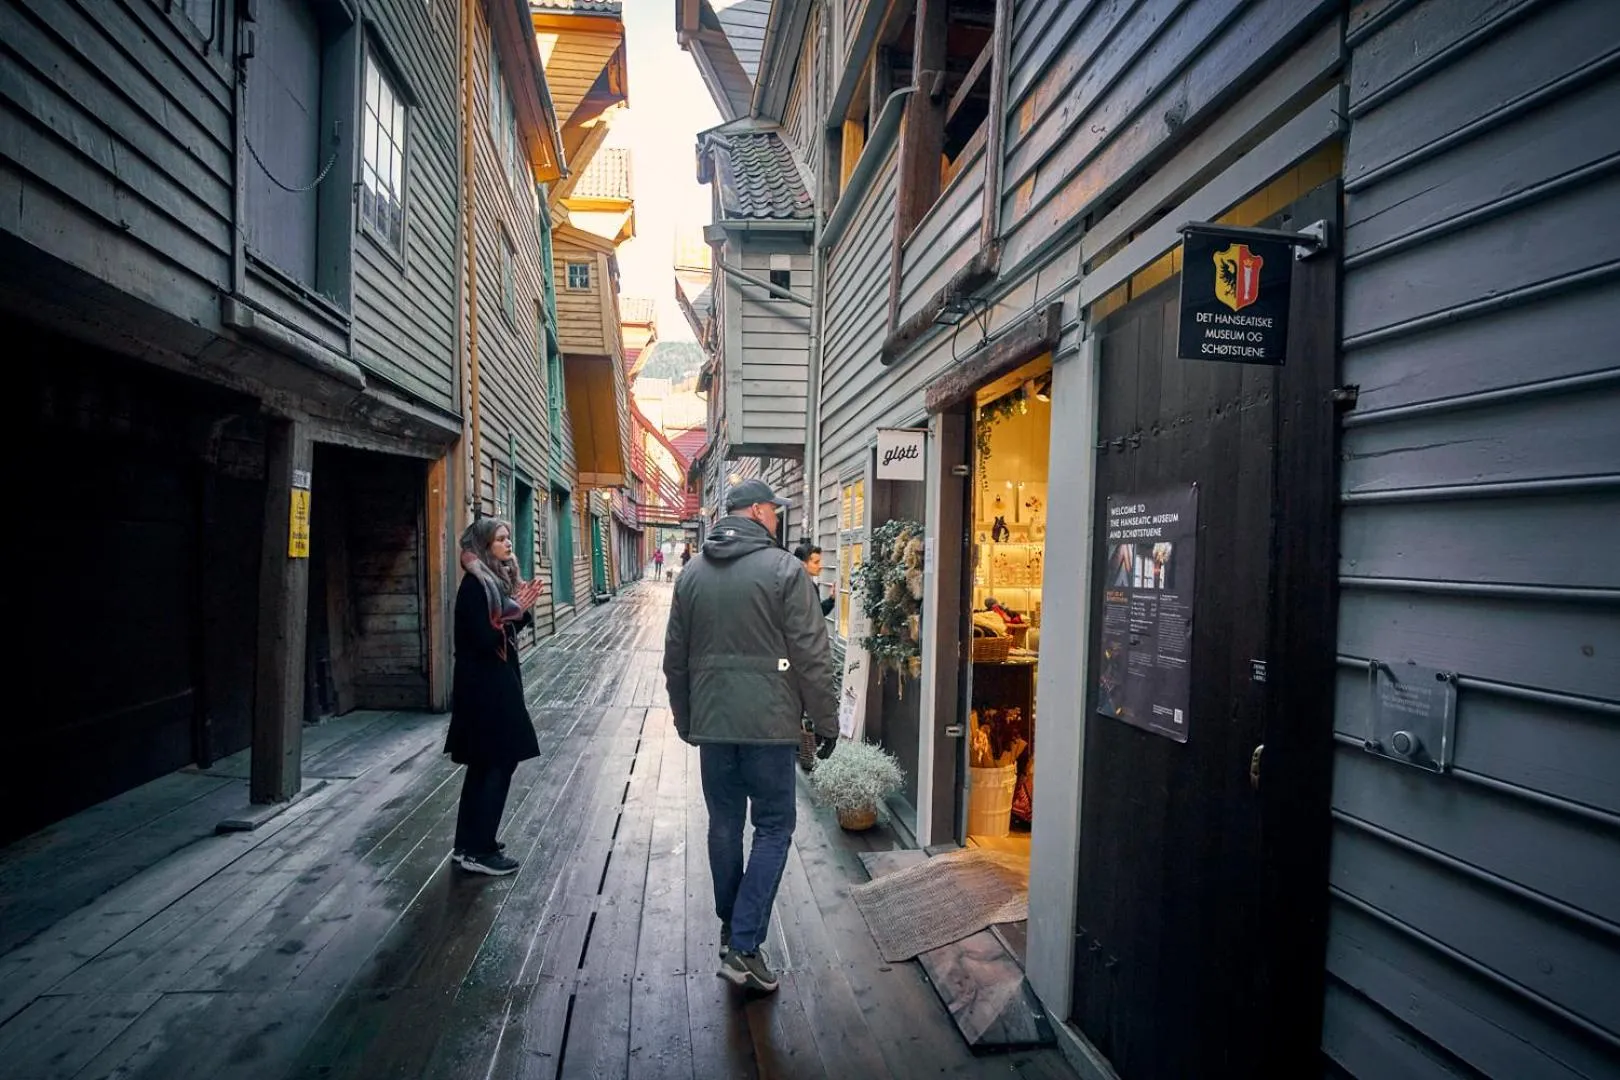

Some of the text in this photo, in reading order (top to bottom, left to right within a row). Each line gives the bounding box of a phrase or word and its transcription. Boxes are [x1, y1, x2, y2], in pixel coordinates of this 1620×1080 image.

[1196, 312, 1273, 328] DET HANSEATISKE
[1205, 328, 1263, 342] MUSEUM OG
[1201, 343, 1265, 358] SCHØTSTUENE
[882, 444, 919, 466] gløtt
[1111, 504, 1145, 515] WELCOME TO
[1110, 514, 1179, 527] THE HANSEATIC MUSEUM
[1109, 530, 1121, 539] AND
